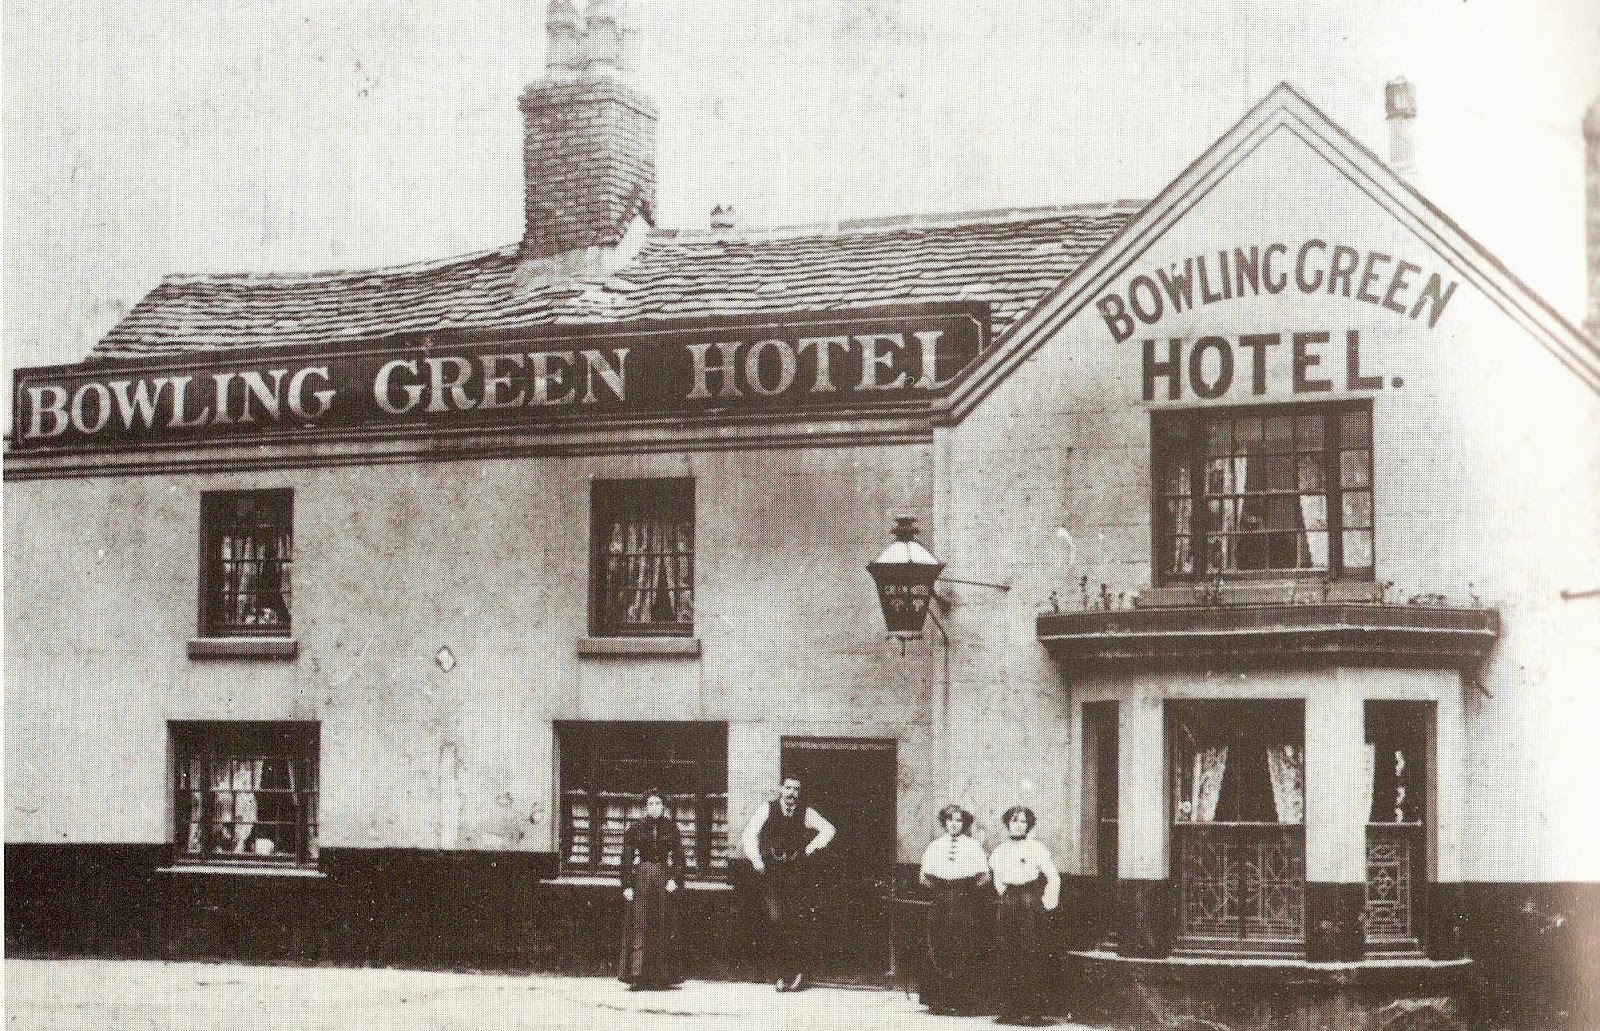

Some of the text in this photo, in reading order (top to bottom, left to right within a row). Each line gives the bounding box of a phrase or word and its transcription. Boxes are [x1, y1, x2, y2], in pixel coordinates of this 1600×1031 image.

[24, 330, 946, 438] BOWLING GREEN HOTEL
[1143, 330, 1404, 400] HOTEL.
